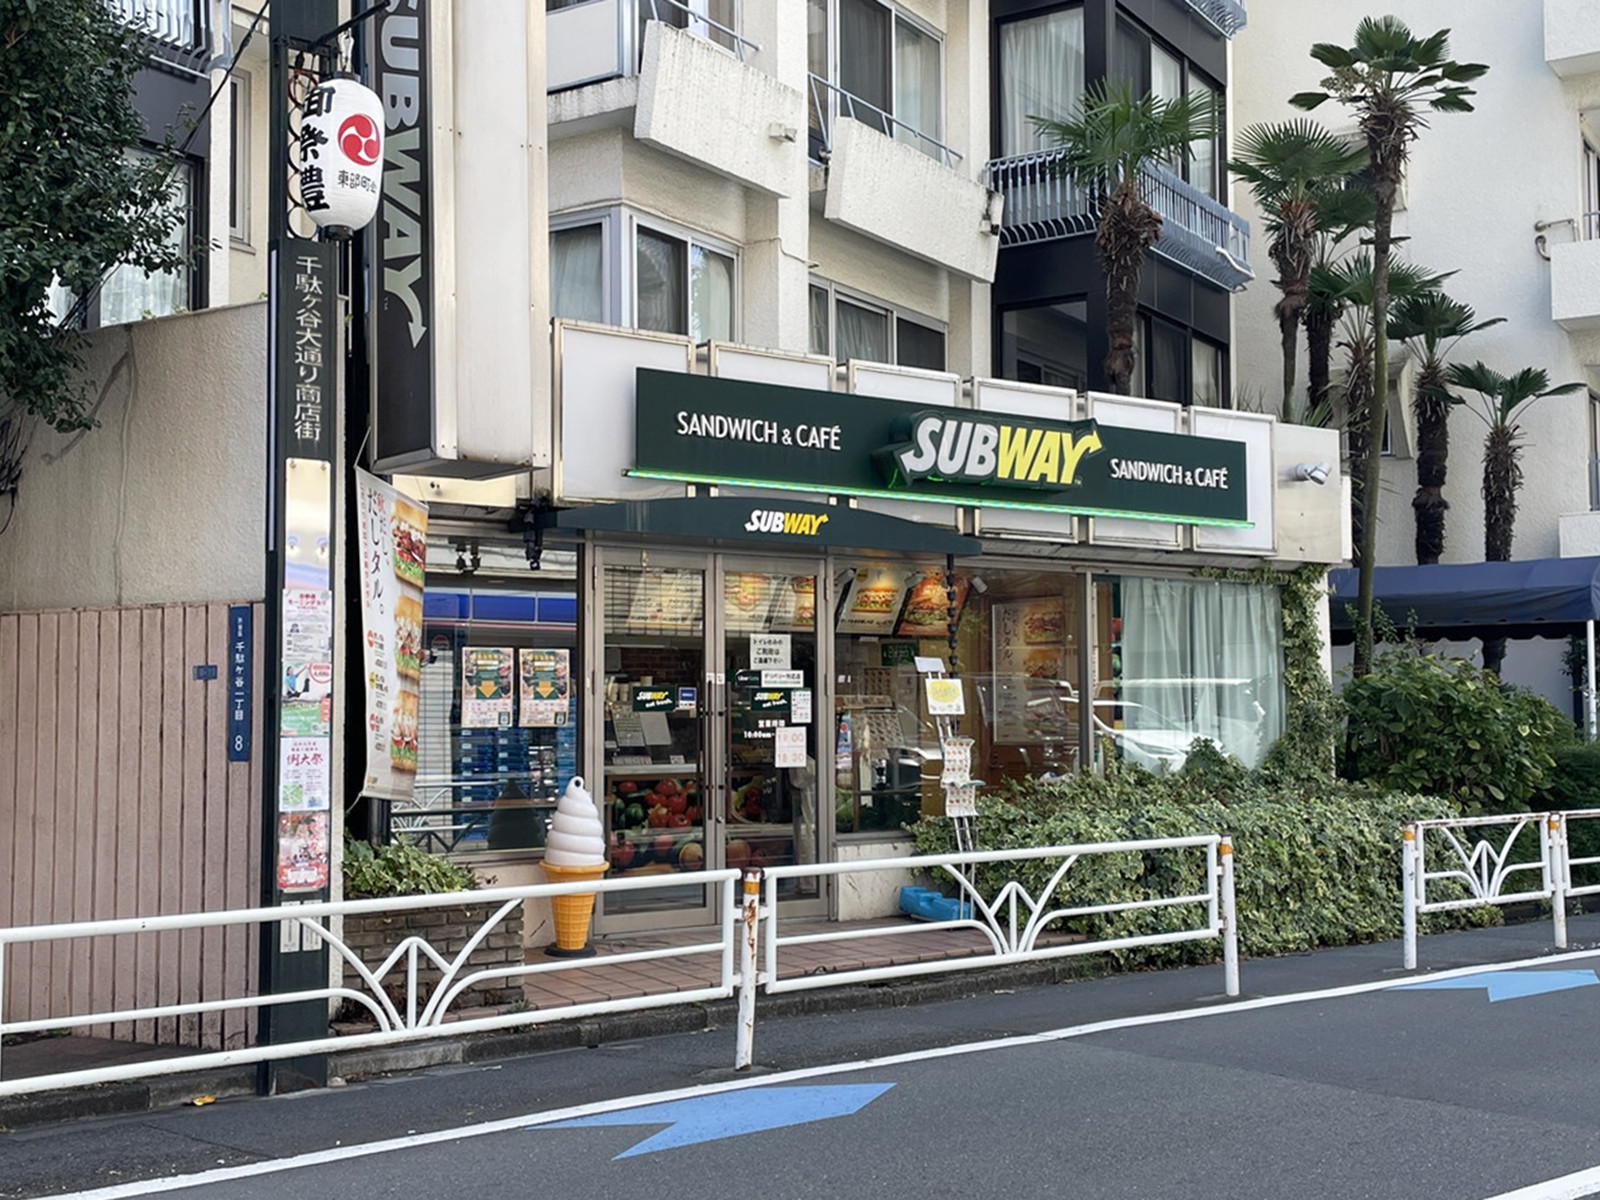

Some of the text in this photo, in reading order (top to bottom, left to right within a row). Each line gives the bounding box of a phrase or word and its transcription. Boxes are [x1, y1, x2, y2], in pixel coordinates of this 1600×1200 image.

[381, 0, 427, 348] UBWAY
[677, 411, 841, 451] SANDWICH & CAFÉ
[900, 416, 1102, 485] SUBWAY
[1110, 457, 1228, 489] SANDWICH & CAFÉ
[744, 510, 829, 536] SUBWAY
[636, 691, 669, 700] SUBWAY
[754, 692, 784, 701] SUBWAY
[234, 735, 244, 752] 8
